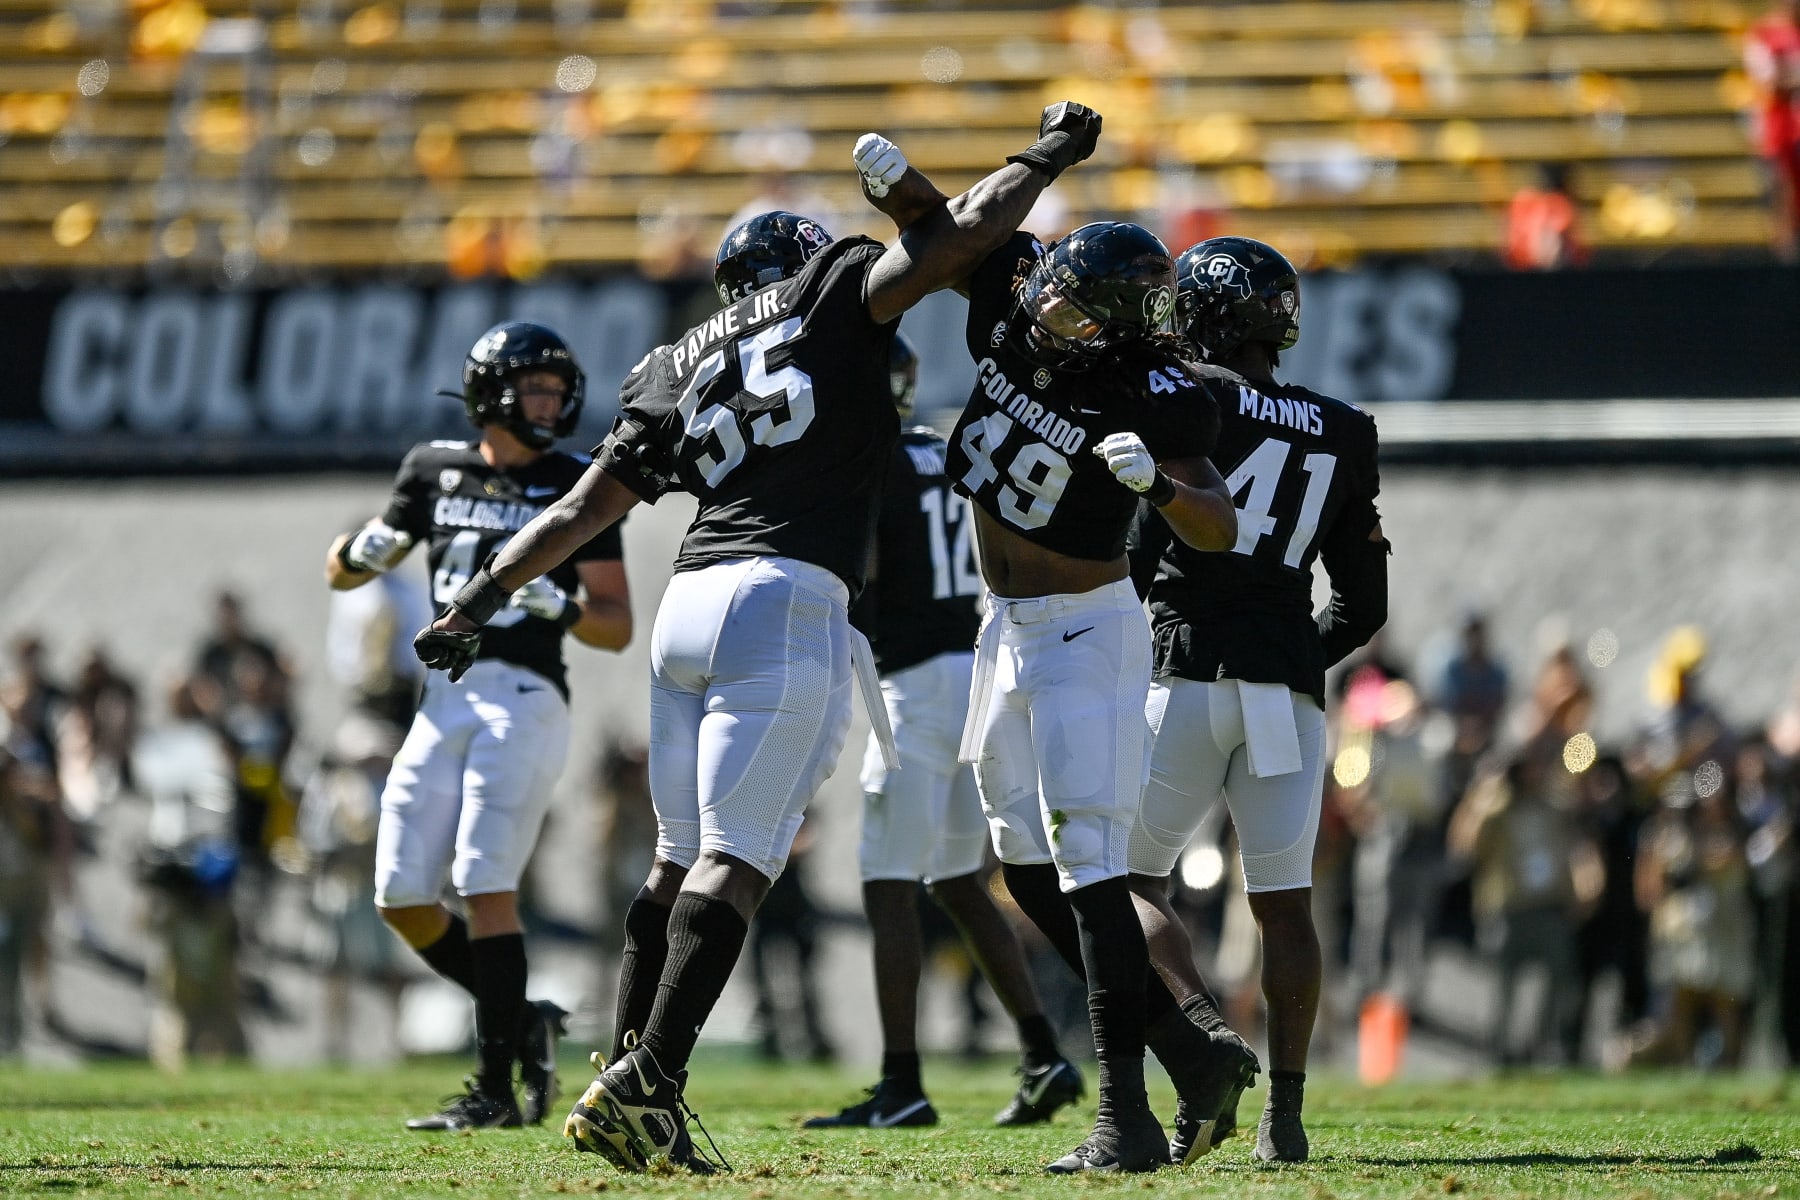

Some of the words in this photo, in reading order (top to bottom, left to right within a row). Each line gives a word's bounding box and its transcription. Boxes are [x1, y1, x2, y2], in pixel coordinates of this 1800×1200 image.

[1207, 257, 1238, 285] CU
[672, 305, 740, 378] PAYNE
[747, 289, 788, 324] JR.
[676, 316, 816, 489] 55
[978, 357, 1086, 456] COLORADO
[1239, 386, 1323, 436] MANNS
[960, 410, 1074, 531] 49
[1223, 437, 1338, 569] 41
[919, 486, 979, 599] 12
